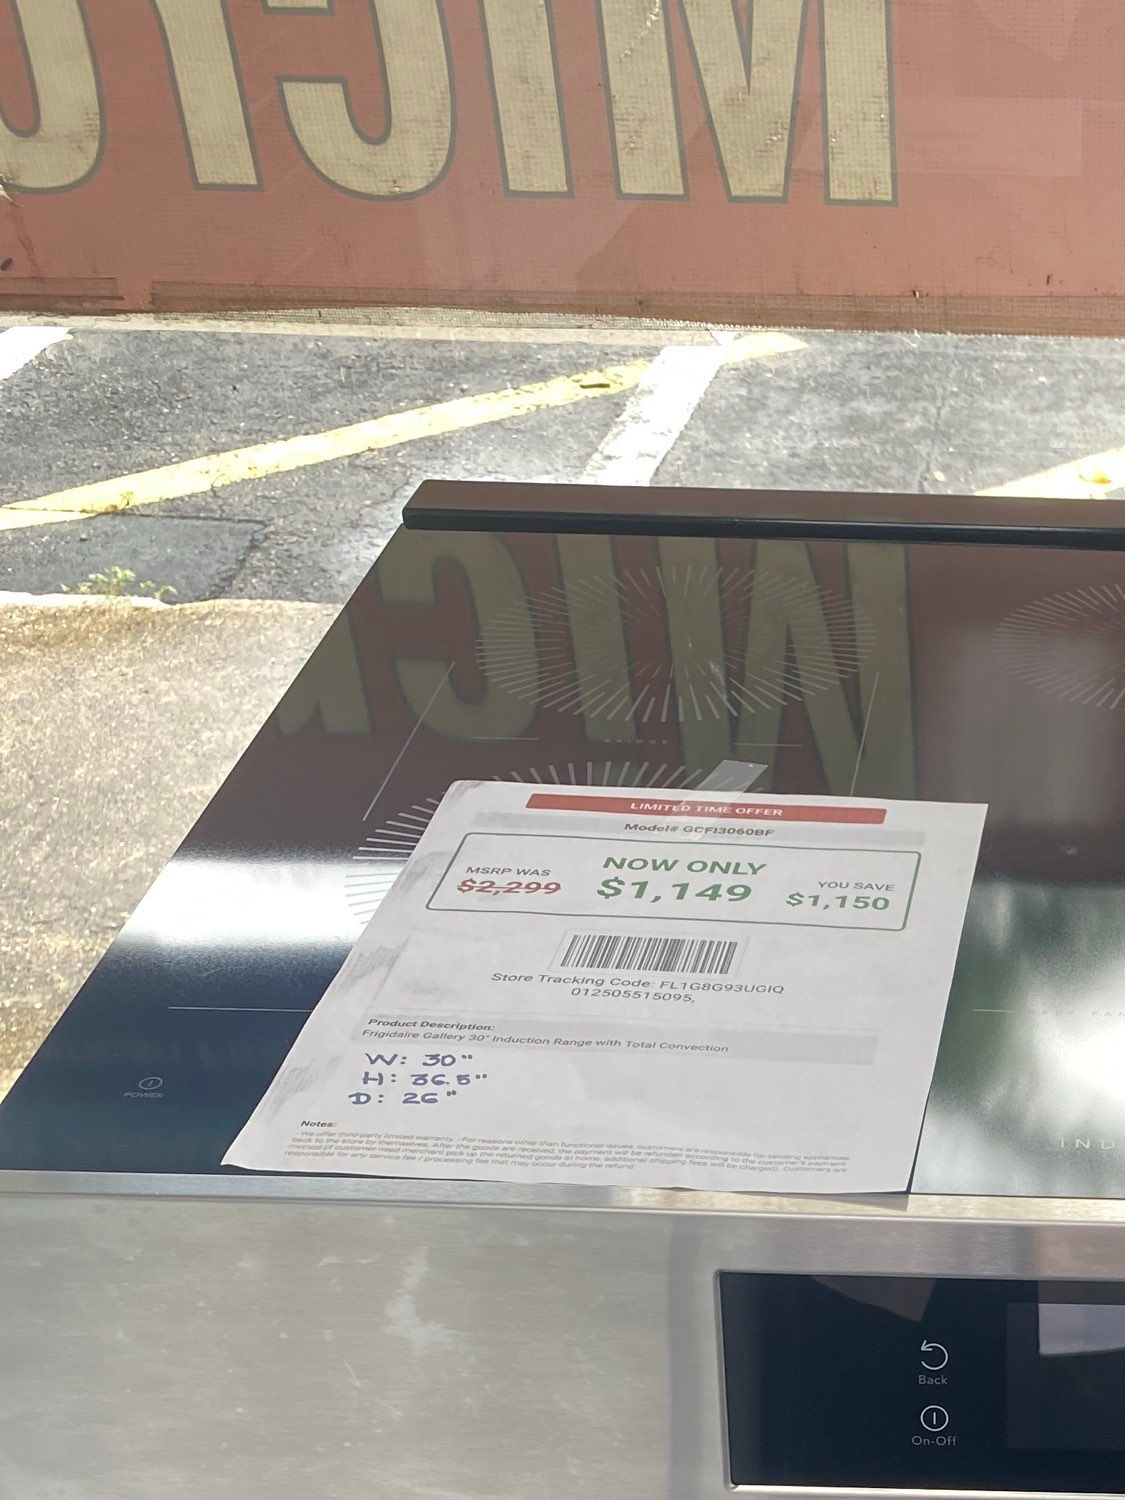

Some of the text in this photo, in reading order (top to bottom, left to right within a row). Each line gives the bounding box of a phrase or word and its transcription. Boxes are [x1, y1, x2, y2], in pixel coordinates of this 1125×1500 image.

[630, 802, 784, 817] LIMITED TIME OFFER
[624, 822, 775, 837] Model# GCFI3060BF
[465, 866, 552, 877] MSRP WAS
[602, 856, 768, 876] NOW ONLY
[457, 877, 562, 897] $2,299
[596, 875, 752, 904] $1,149
[818, 881, 896, 892] YOU SAVE
[785, 891, 890, 911] $1,150
[491, 972, 534, 984] Store
[538, 974, 605, 987] Tracking
[609, 977, 655, 989] Code:
[367, 1018, 496, 1032] Product Description:
[361, 1028, 420, 1040] Frigidaire
[422, 1031, 466, 1043] Gallery
[492, 1035, 551, 1046] Induction
[553, 1037, 593, 1049] Range
[595, 1038, 622, 1048] with
[625, 1039, 657, 1050] Total
[659, 1042, 730, 1053] Convection
[364, 1052, 474, 1067] W: 30"
[362, 1070, 397, 1086] H:
[123, 1091, 165, 1099] POWER
[347, 1089, 458, 1106] D: 26"
[300, 1120, 336, 1128] Notes:
[918, 1374, 949, 1386] Back
[911, 1435, 958, 1447] On-Off
